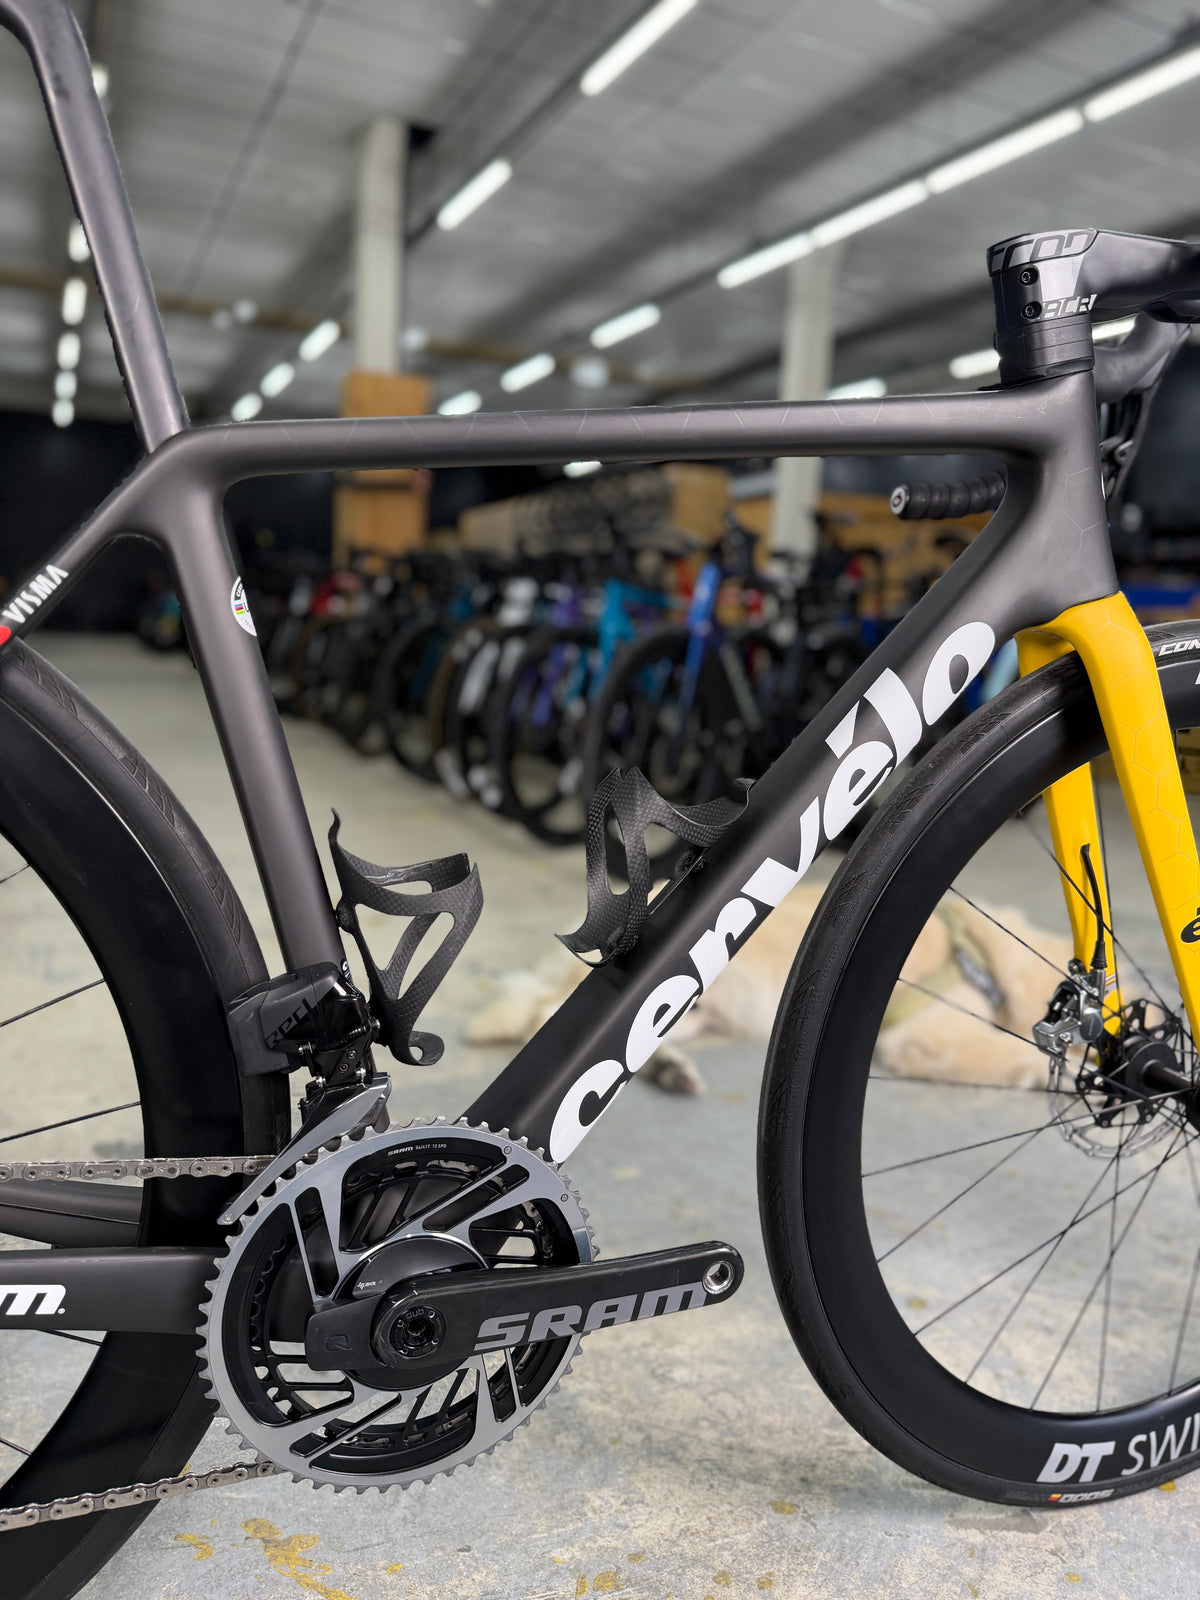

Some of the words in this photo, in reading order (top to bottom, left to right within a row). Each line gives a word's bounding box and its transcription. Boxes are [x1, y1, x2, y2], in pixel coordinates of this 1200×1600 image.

[2, 564, 69, 624] VISMA
[550, 621, 996, 1164] cervélo
[473, 1281, 707, 1350] SRAM
[1036, 1441, 1116, 1483] DT
